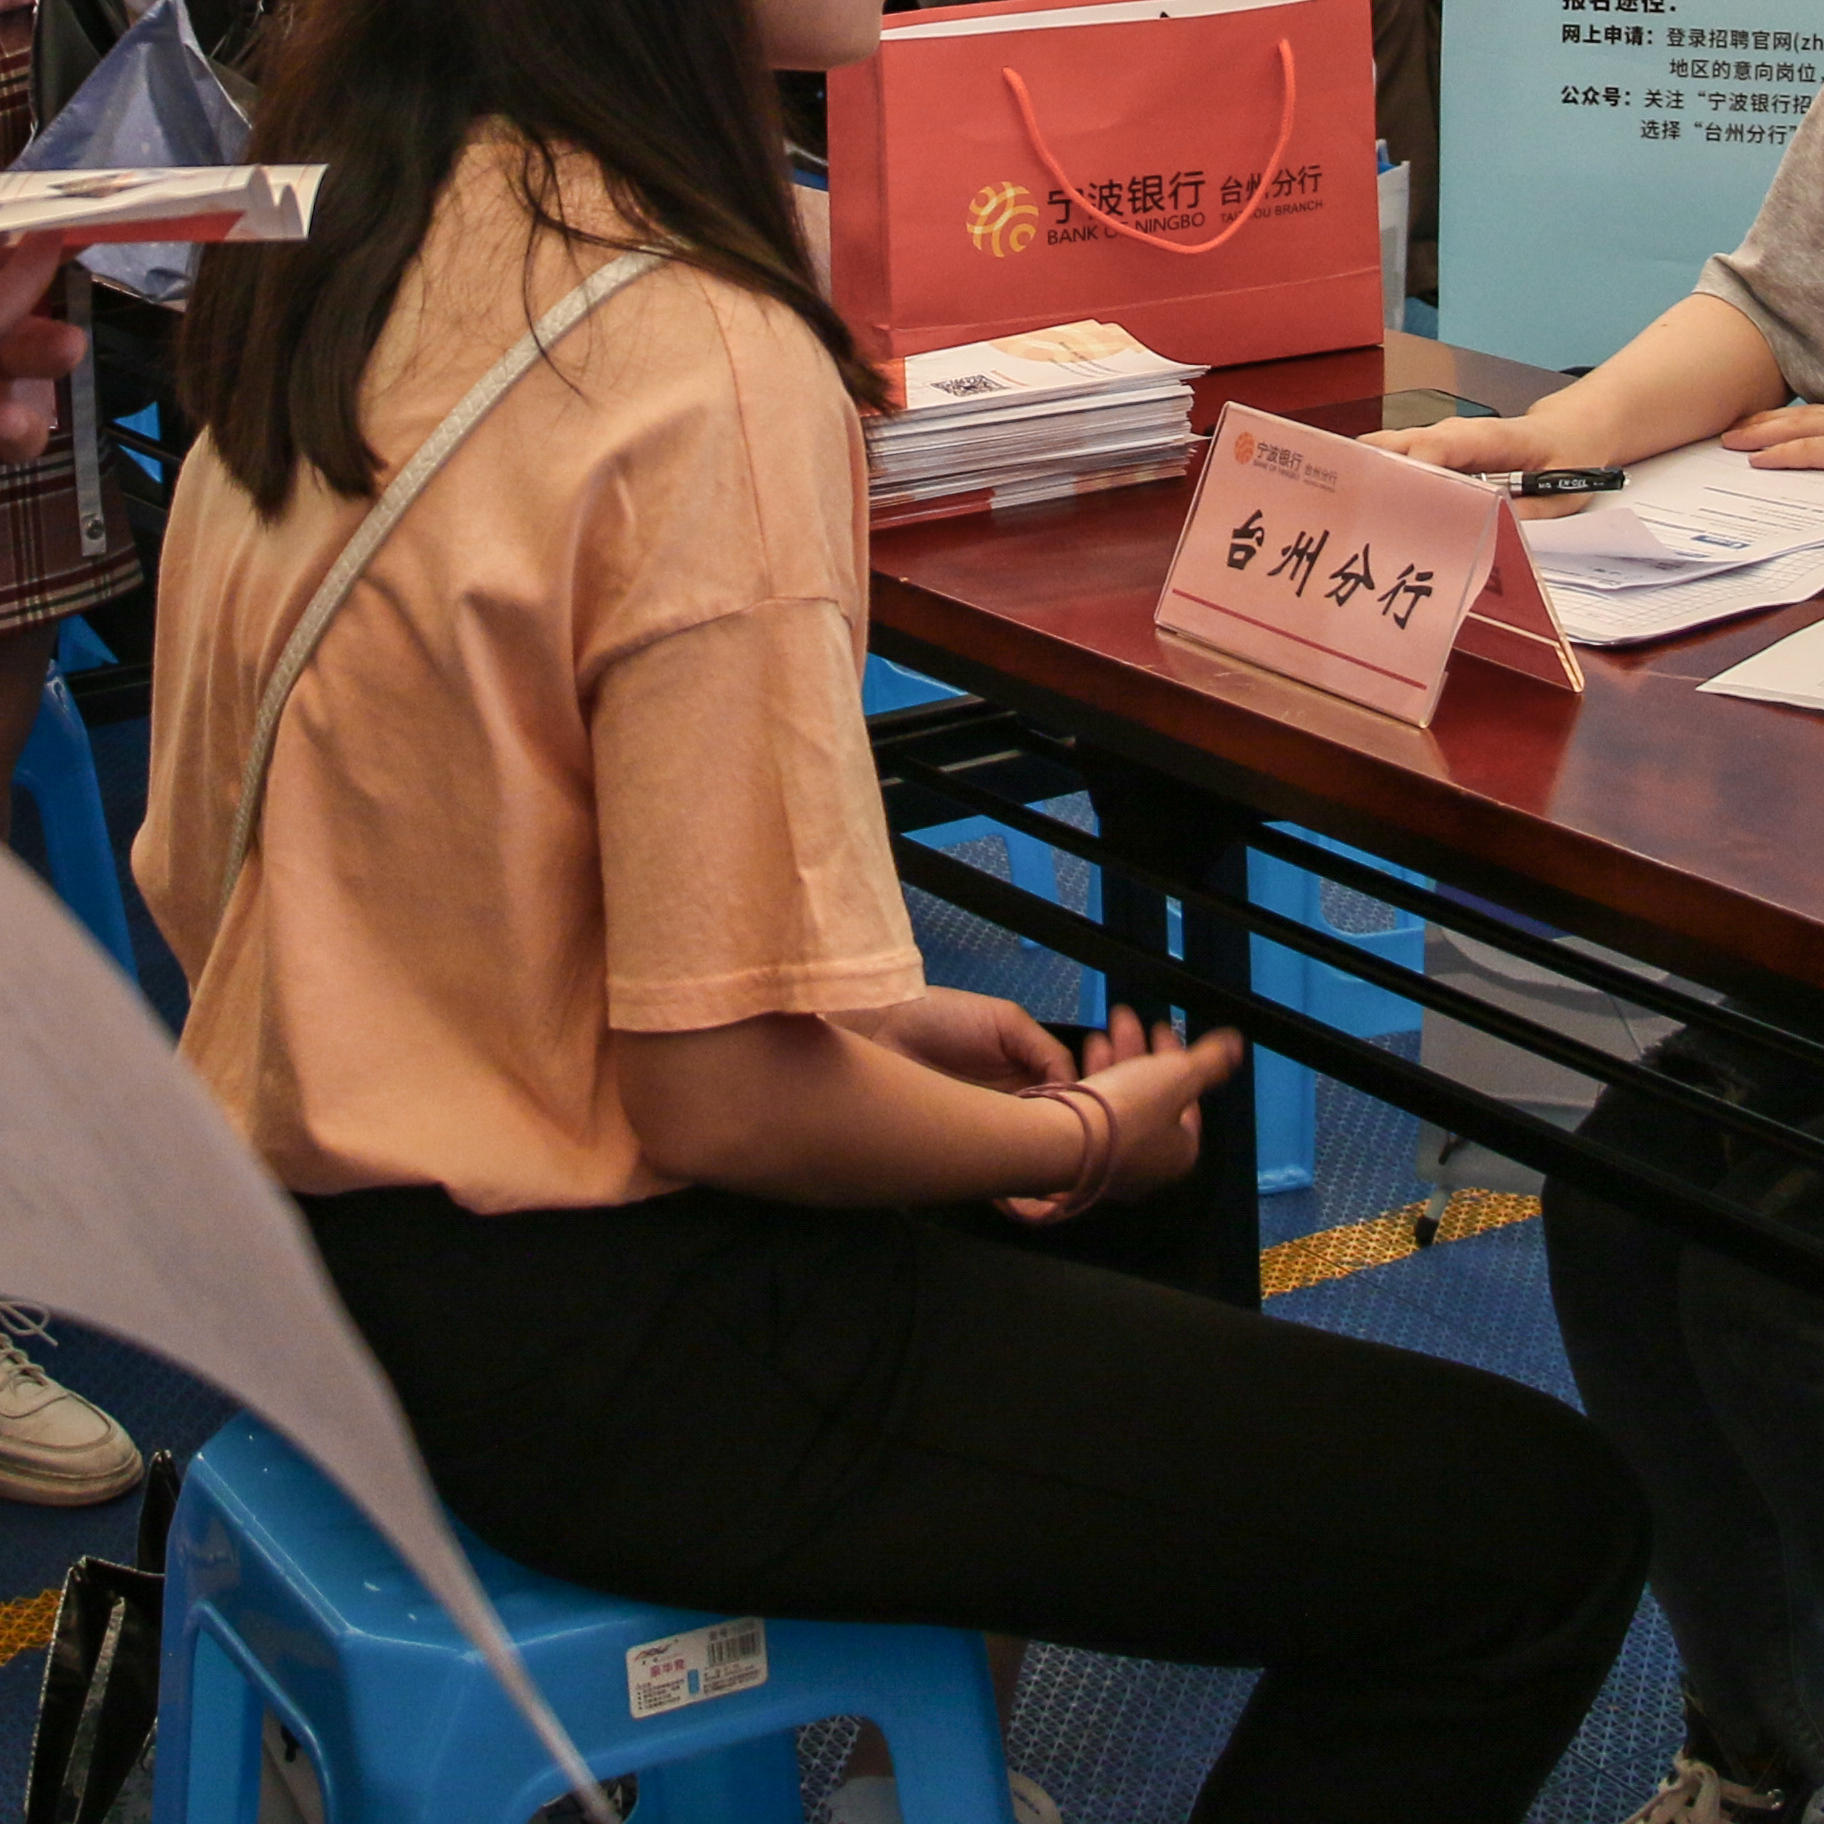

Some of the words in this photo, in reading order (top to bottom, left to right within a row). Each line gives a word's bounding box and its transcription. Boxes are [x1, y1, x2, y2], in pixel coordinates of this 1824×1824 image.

[1047, 170, 1206, 224] 宁波银行
[1220, 165, 1323, 207] 台州分行
[1047, 225, 1099, 245] BANK
[1135, 212, 1206, 235] NINGBO
[1220, 207, 1271, 224] TAIOU
[1276, 199, 1324, 217] BRANCH
[1256, 442, 1304, 471] 宁波银行
[1226, 508, 1434, 630] 台州分行
